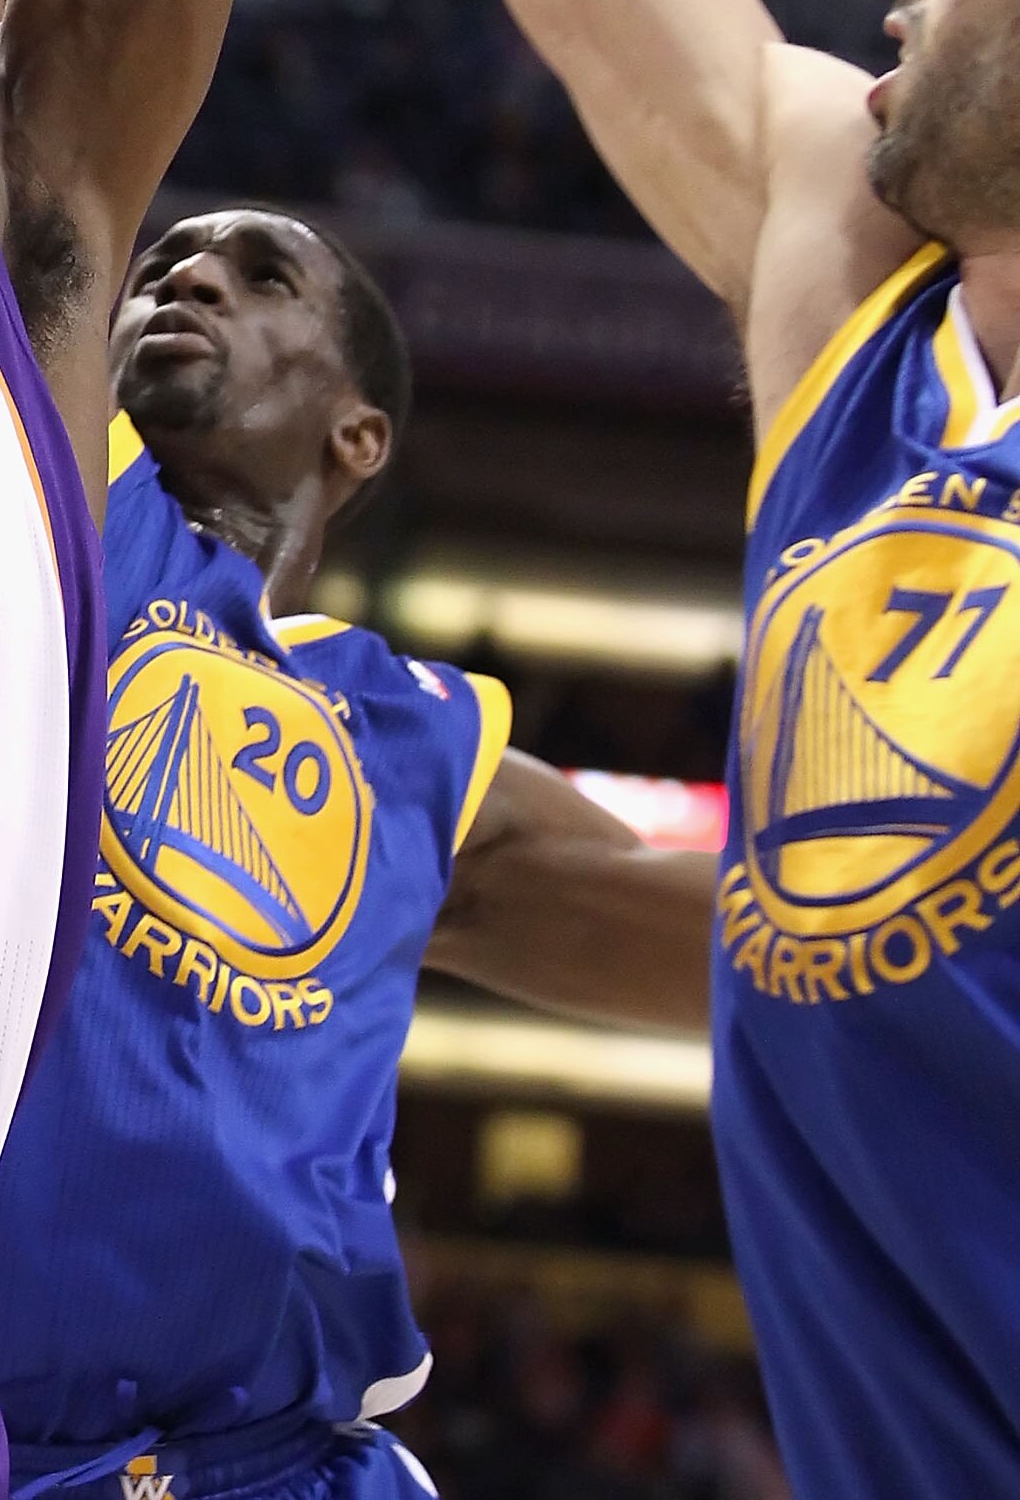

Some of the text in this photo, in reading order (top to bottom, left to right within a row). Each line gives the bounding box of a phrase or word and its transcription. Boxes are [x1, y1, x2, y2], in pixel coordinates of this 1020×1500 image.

[866, 583, 1010, 682] 77
[232, 706, 331, 815] 20
[92, 872, 334, 1031] ARRIORS
